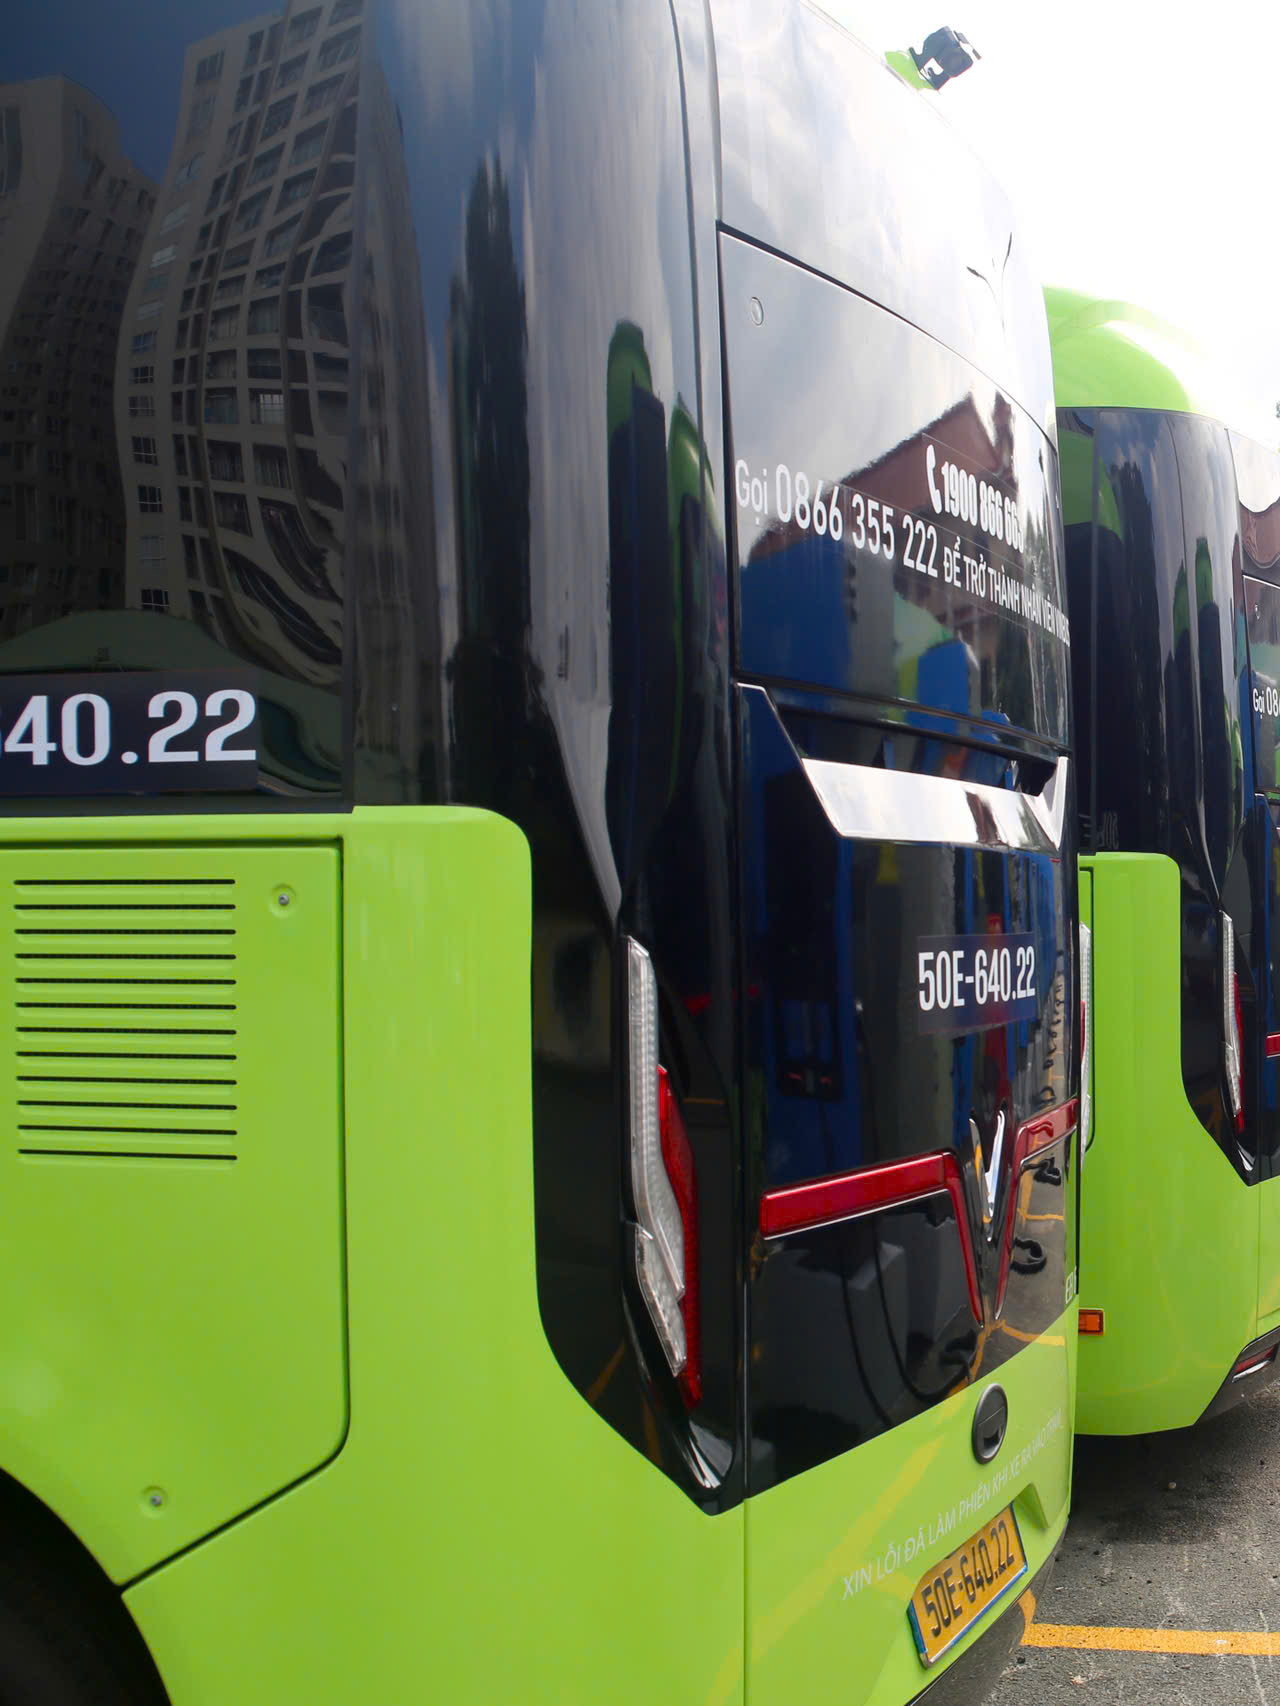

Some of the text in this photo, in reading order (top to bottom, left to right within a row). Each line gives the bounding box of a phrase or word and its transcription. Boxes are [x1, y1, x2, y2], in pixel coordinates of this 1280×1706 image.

[735, 459, 768, 525] Gọi
[775, 464, 844, 542] 0866
[851, 493, 895, 560] 355
[902, 514, 938, 578] 222
[943, 536, 962, 588] ĐỂ
[963, 553, 987, 598] TRỞ
[988, 565, 1020, 615] THÀNH
[941, 461, 978, 527] 1900
[979, 480, 1004, 541] 866
[0, 689, 257, 766] 40.22
[918, 945, 1035, 1011] 50E-640.22
[921, 1519, 1015, 1638] 50E-640.22
